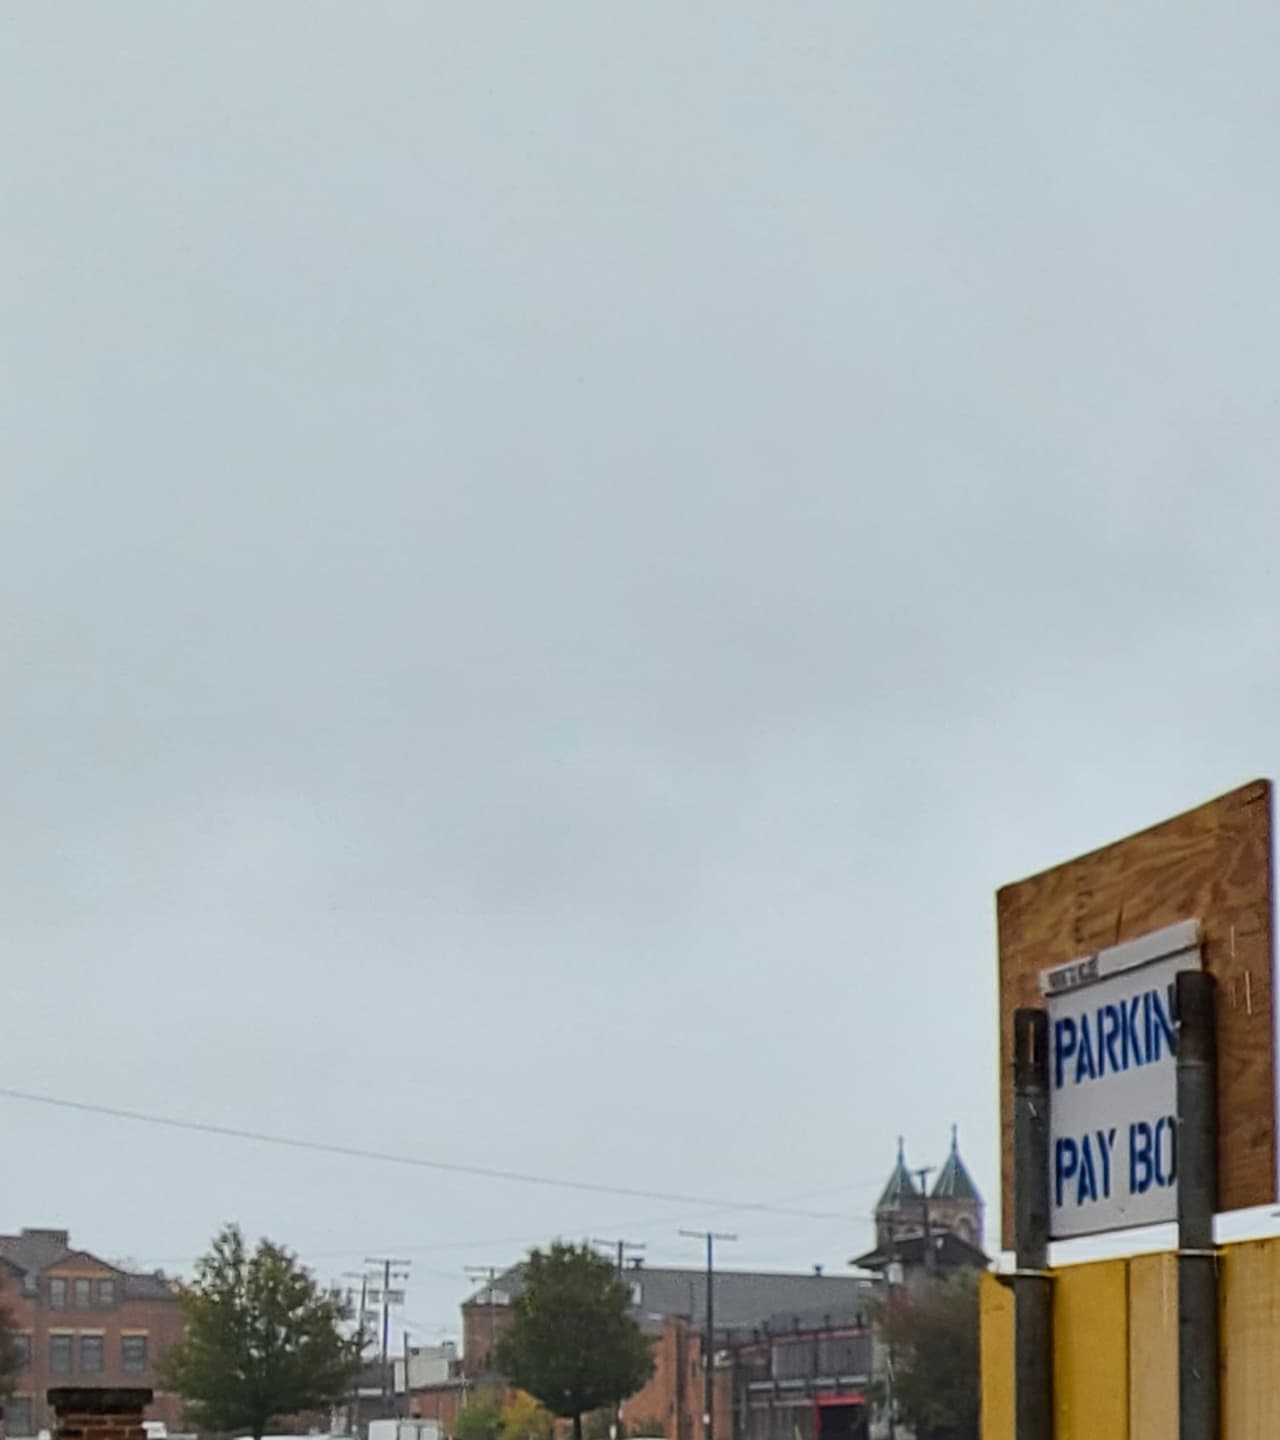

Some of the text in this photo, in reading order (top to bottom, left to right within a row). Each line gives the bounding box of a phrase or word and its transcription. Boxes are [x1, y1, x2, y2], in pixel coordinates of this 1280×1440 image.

[1054, 984, 1179, 1089] PARKIN
[1055, 1116, 1179, 1207] PAY BO
